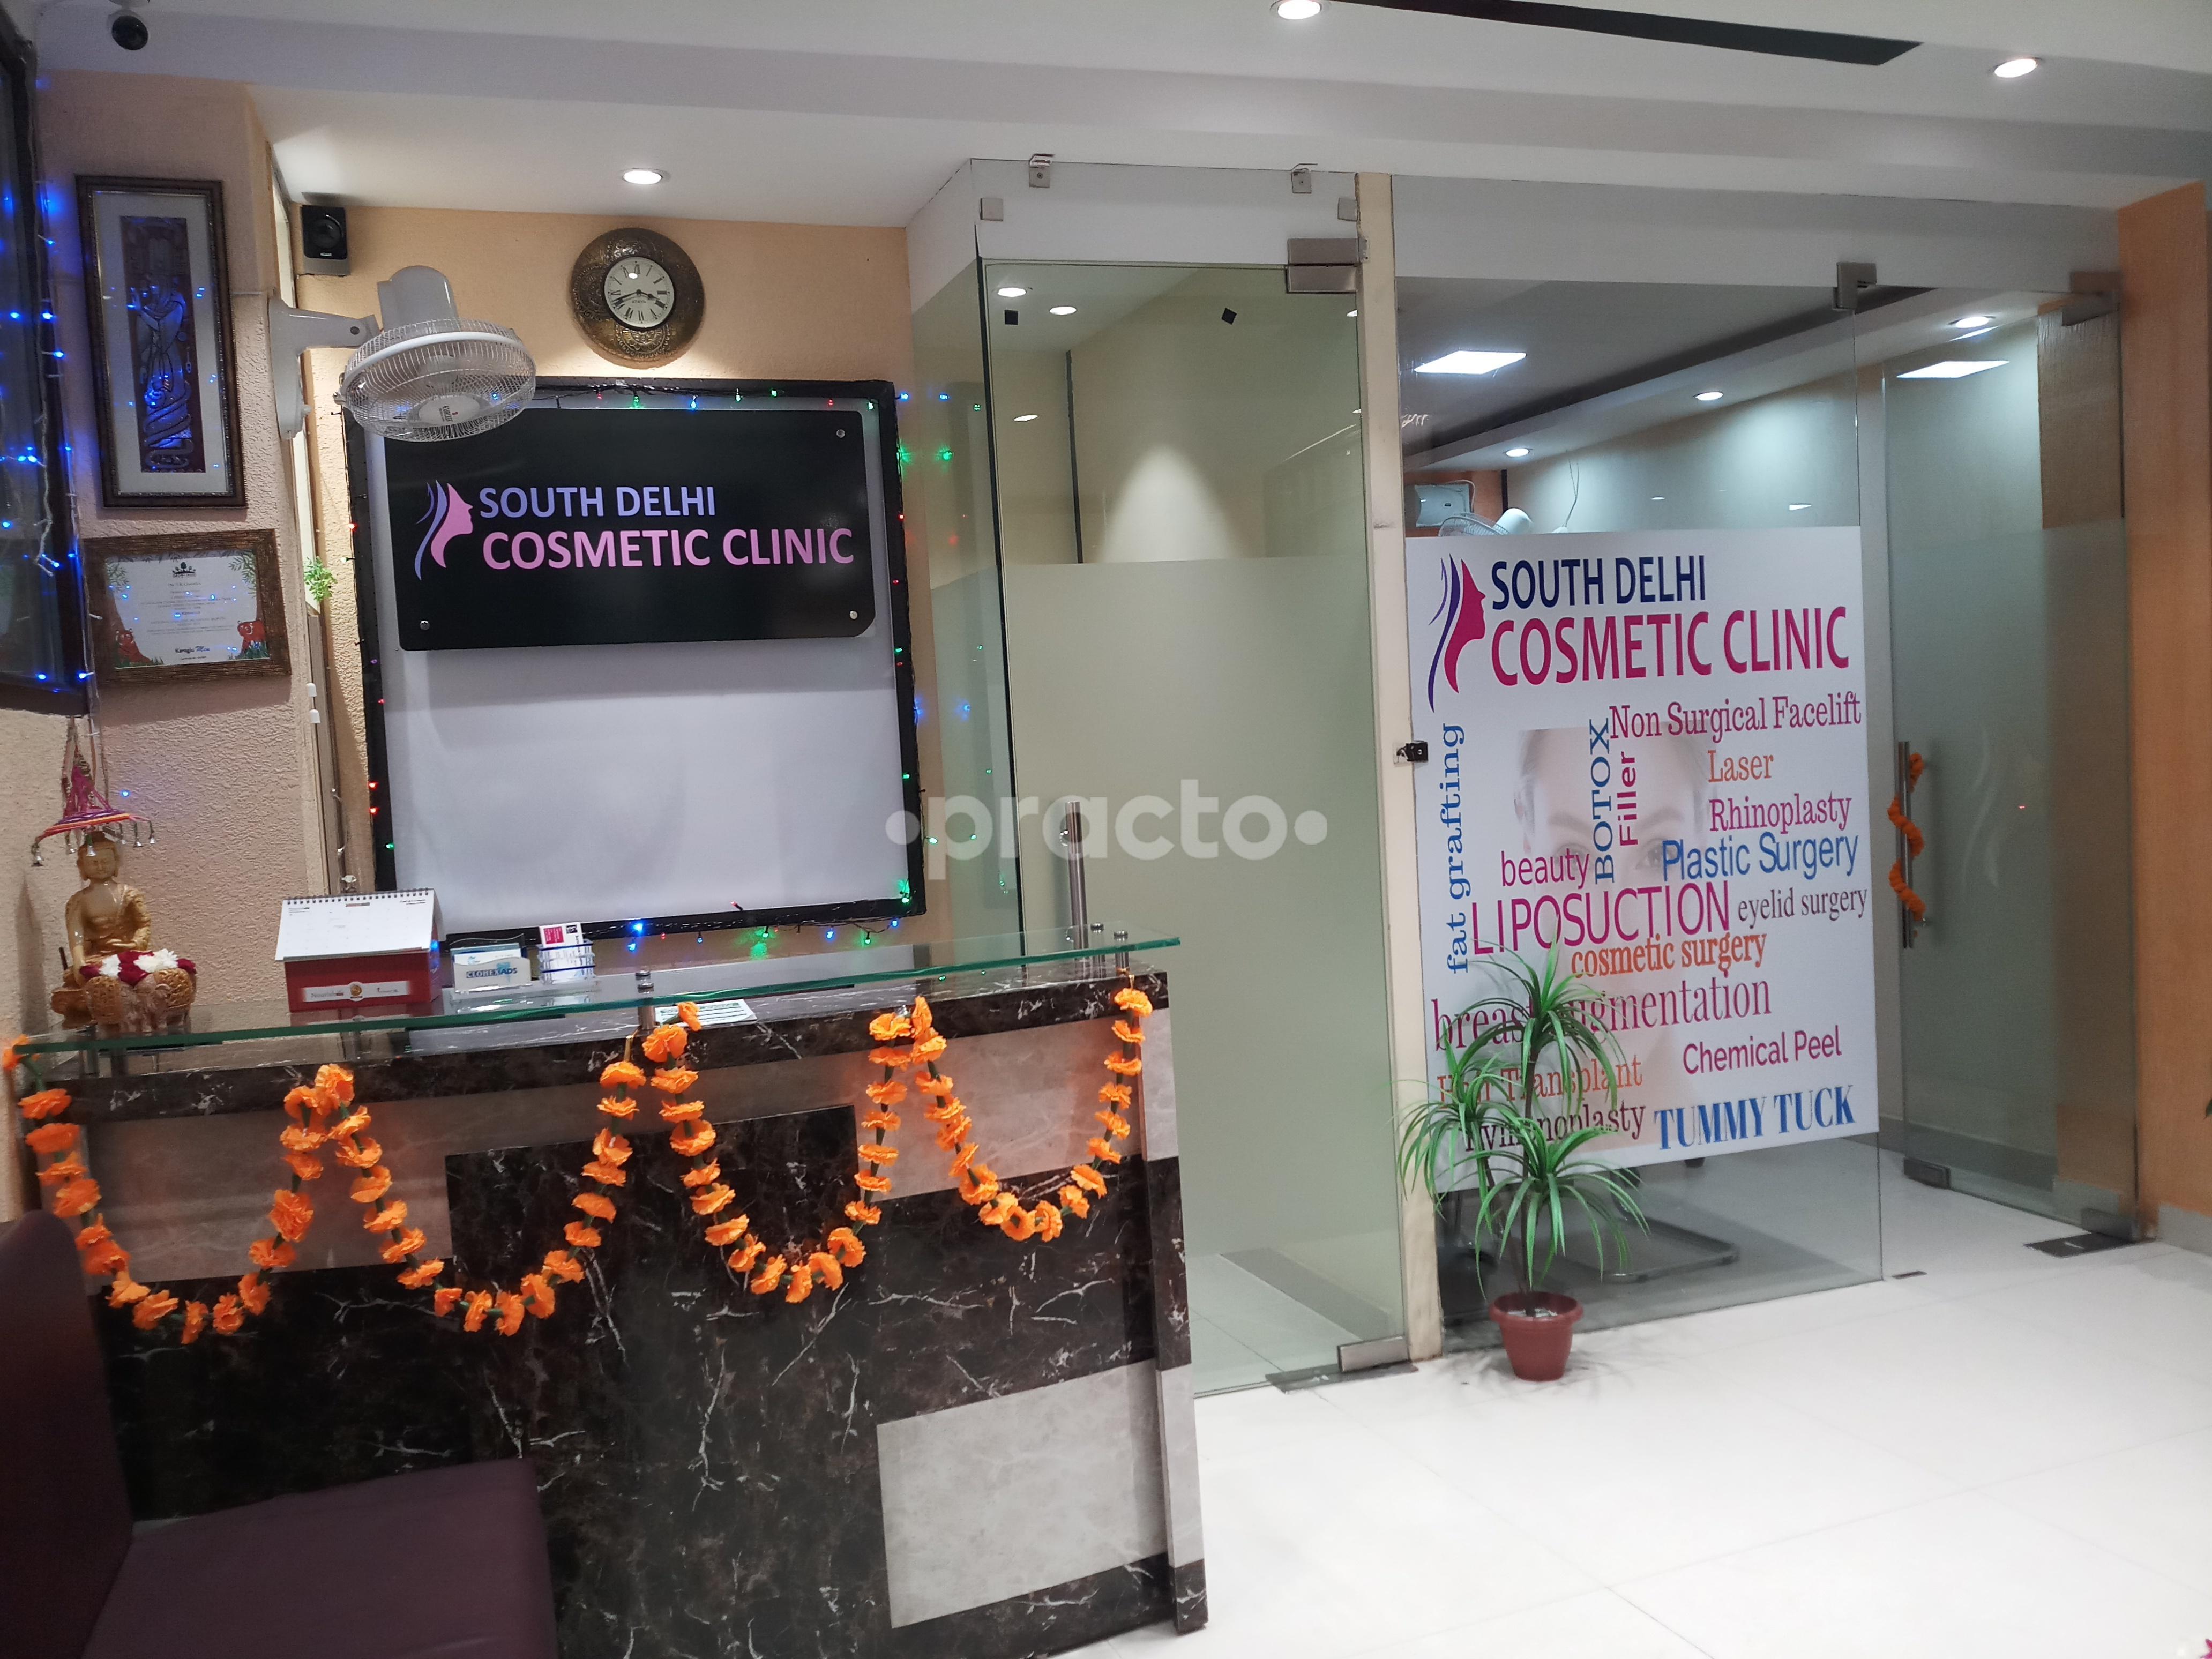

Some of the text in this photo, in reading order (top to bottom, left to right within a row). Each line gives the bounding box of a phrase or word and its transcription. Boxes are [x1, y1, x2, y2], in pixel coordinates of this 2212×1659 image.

[480, 486, 715, 518] SOUTH DELHI
[483, 528, 854, 570] COSMETIC CLINIC
[1491, 555, 1706, 610] SOUTH DELHI
[1491, 606, 1849, 686] COSMETIC CLINIC
[1609, 691, 1862, 744] Non Surgical Facelift
[1707, 750, 1774, 782] Laser
[1589, 718, 1615, 884] BOTOX
[1618, 751, 1638, 847] Filler
[1709, 797, 1852, 835] Rhinoplasty
[1440, 723, 1470, 974] fat grafting
[1501, 850, 1590, 889] beauty
[1661, 831, 1859, 882] Plastic Surgery
[1471, 880, 1730, 955] LIPOSUCTION
[1738, 886, 1868, 929] eyelid surgery
[1571, 931, 1767, 979] cosmetic surgery
[1549, 966, 1772, 1045] ugmentation
[1683, 1025, 1842, 1075] Chemical Peel
[1500, 1055, 1643, 1101] Tansplant
[1654, 1085, 1855, 1150] TUMMY TUCK
